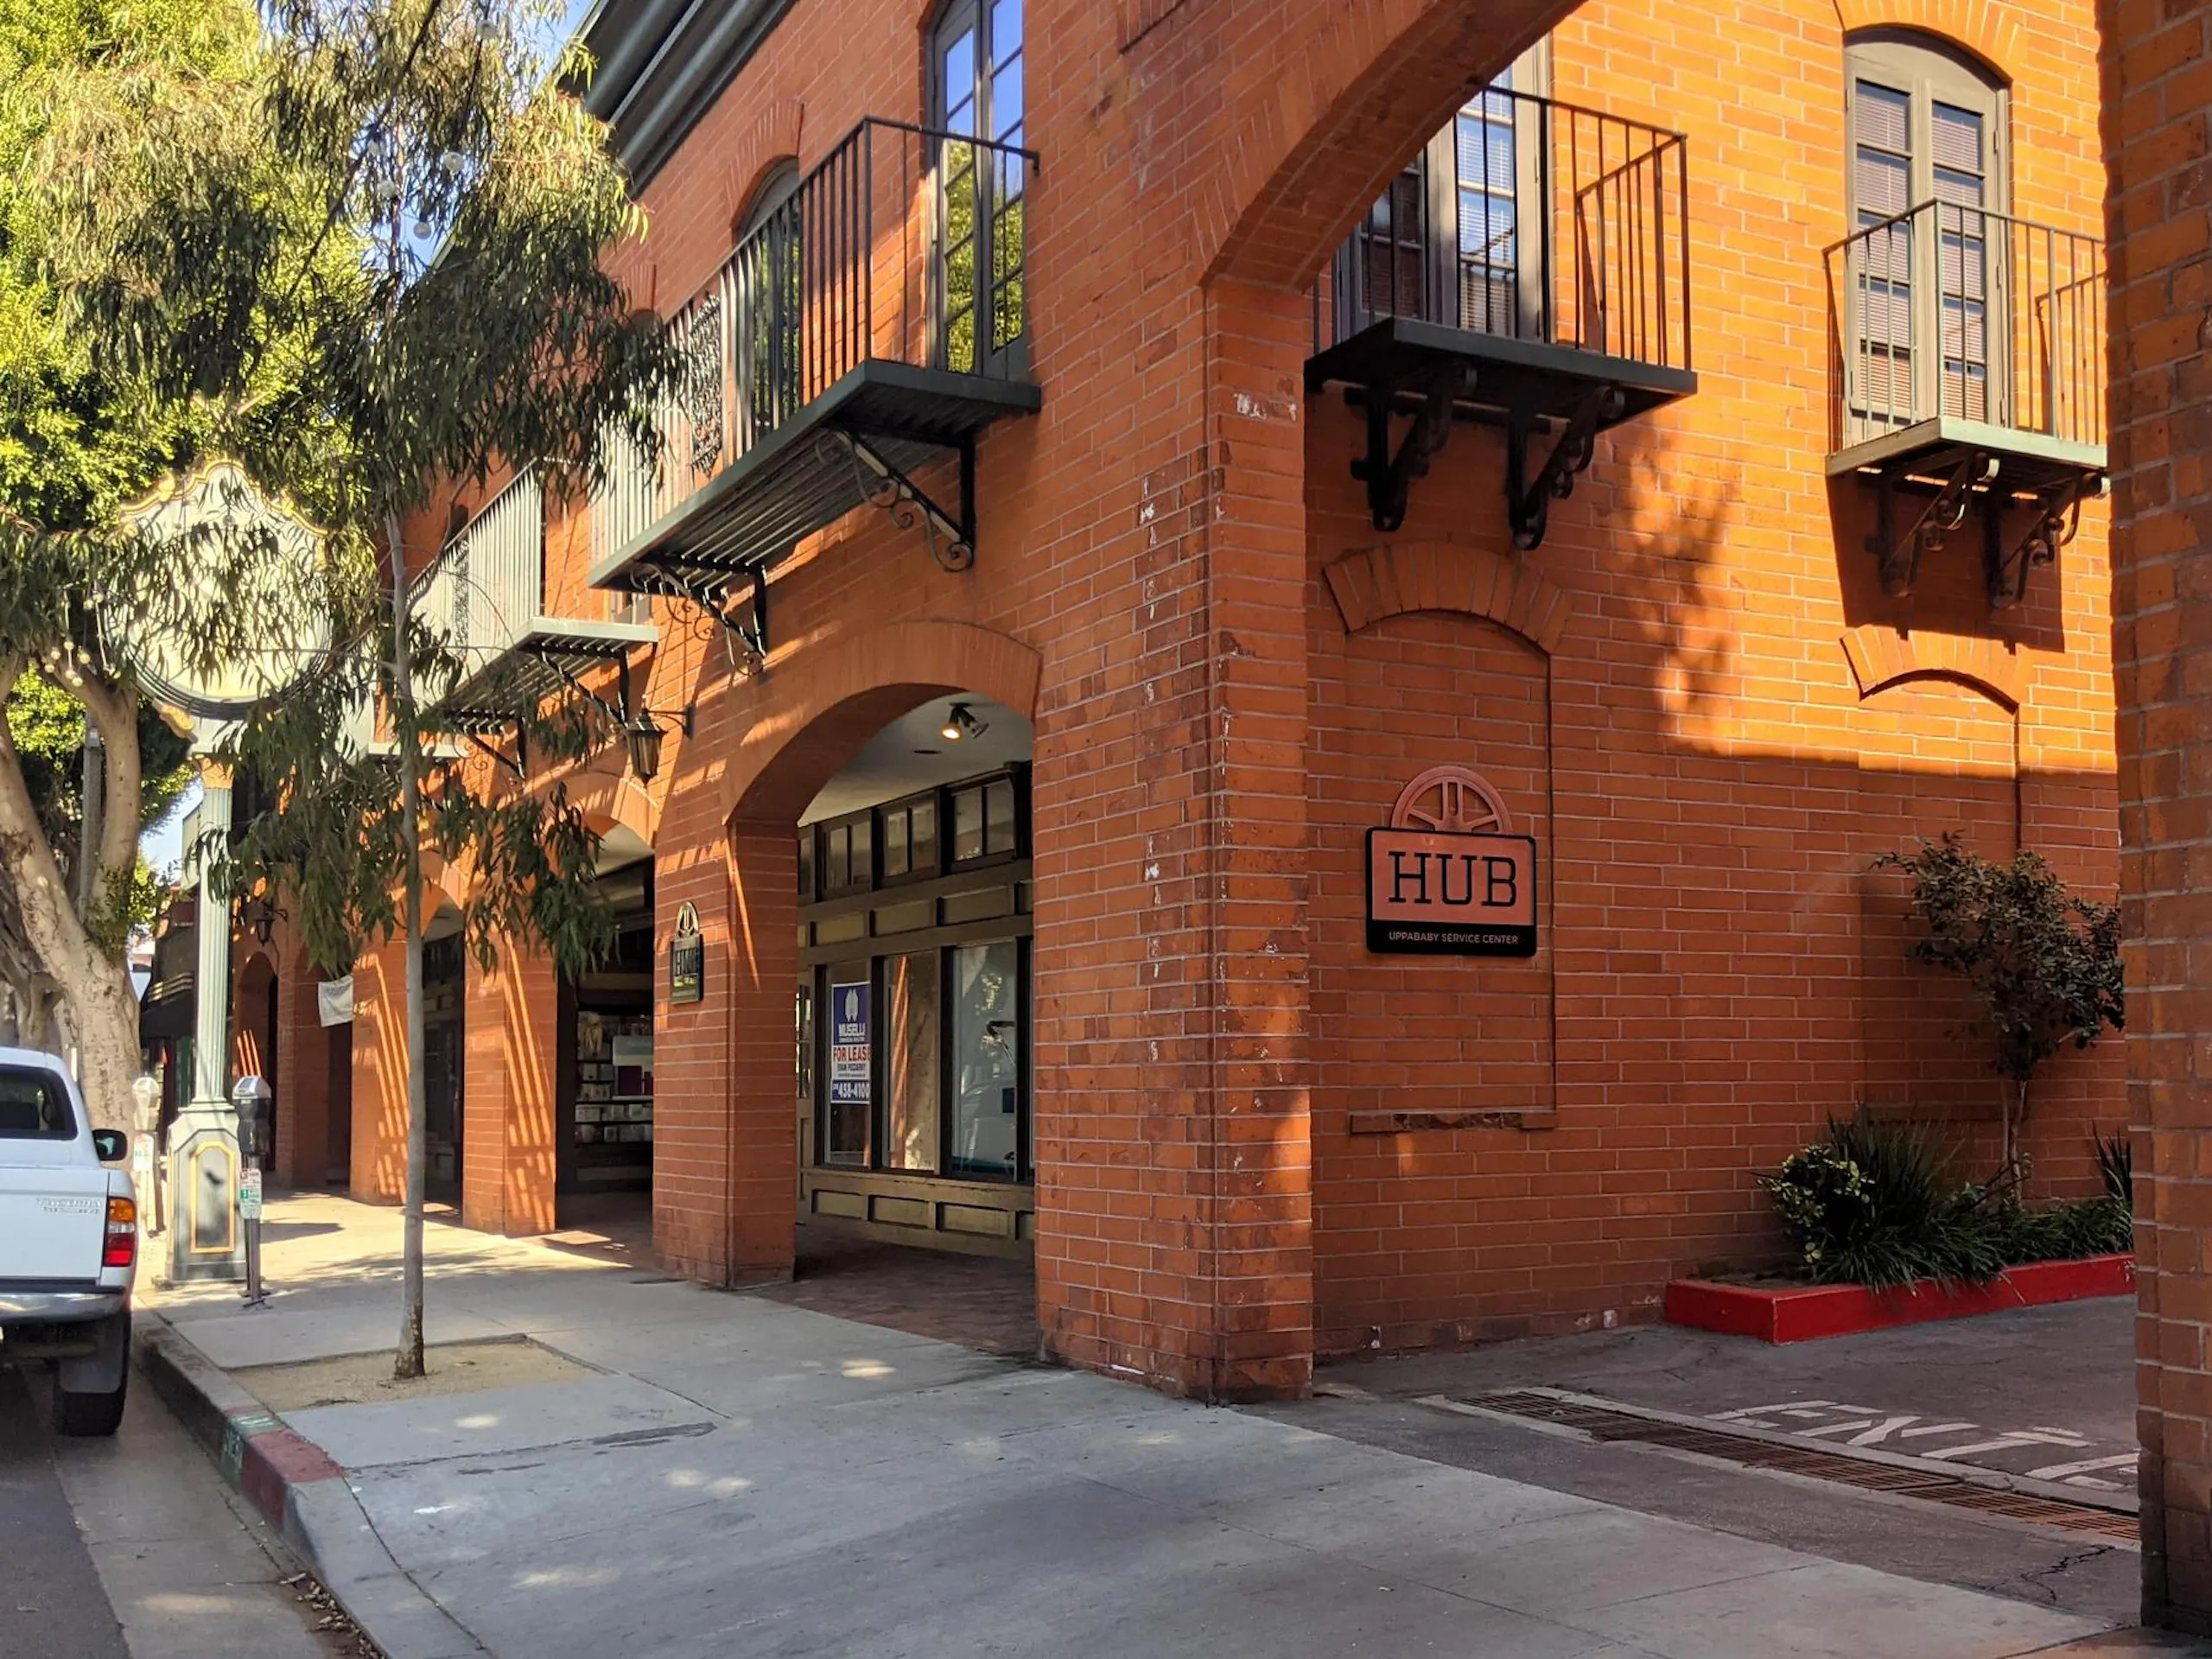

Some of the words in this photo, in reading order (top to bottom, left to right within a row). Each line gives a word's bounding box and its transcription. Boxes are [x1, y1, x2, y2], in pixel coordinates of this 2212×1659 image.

[1388, 851, 1517, 907] HUB
[1388, 931, 1440, 942] UPPABABY
[1441, 932, 1481, 944] SERVICE
[1482, 934, 1520, 945] CENTER
[833, 1046, 847, 1062] FOR
[1701, 1399, 2140, 1491] ENTE
